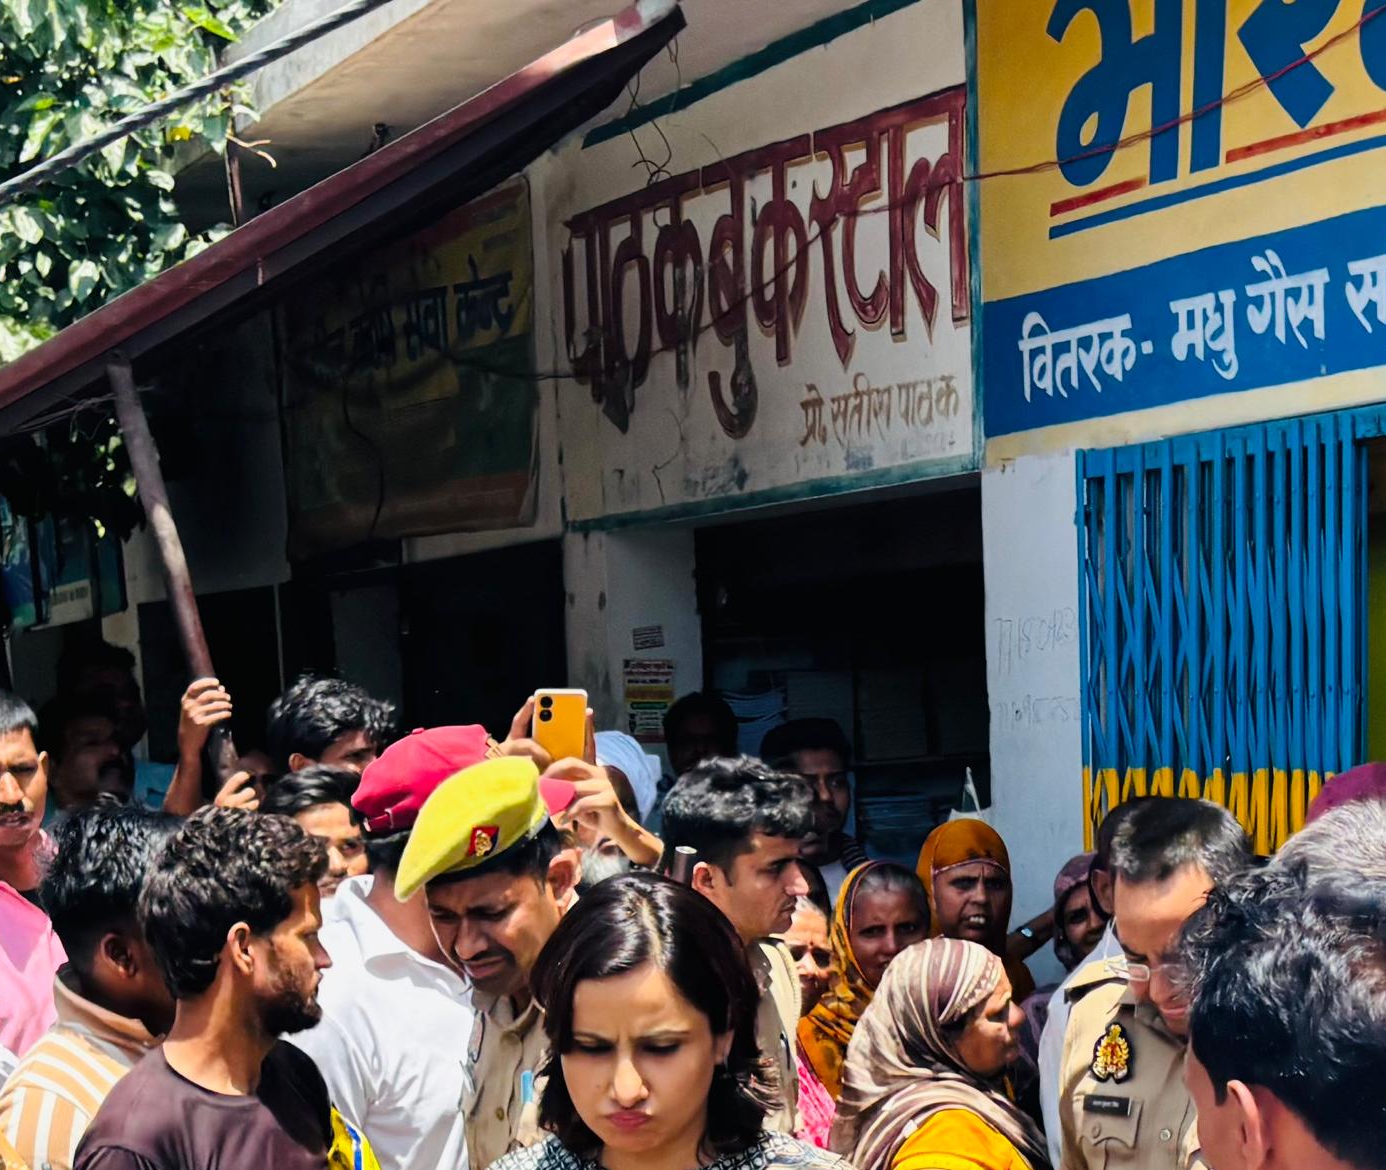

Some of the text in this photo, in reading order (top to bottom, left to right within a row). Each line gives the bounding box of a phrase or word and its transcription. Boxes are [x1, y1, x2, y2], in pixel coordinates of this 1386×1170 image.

[701, 133, 812, 438] बुक
[1170, 288, 1239, 380] मधु
[1245, 249, 1330, 349] गैस
